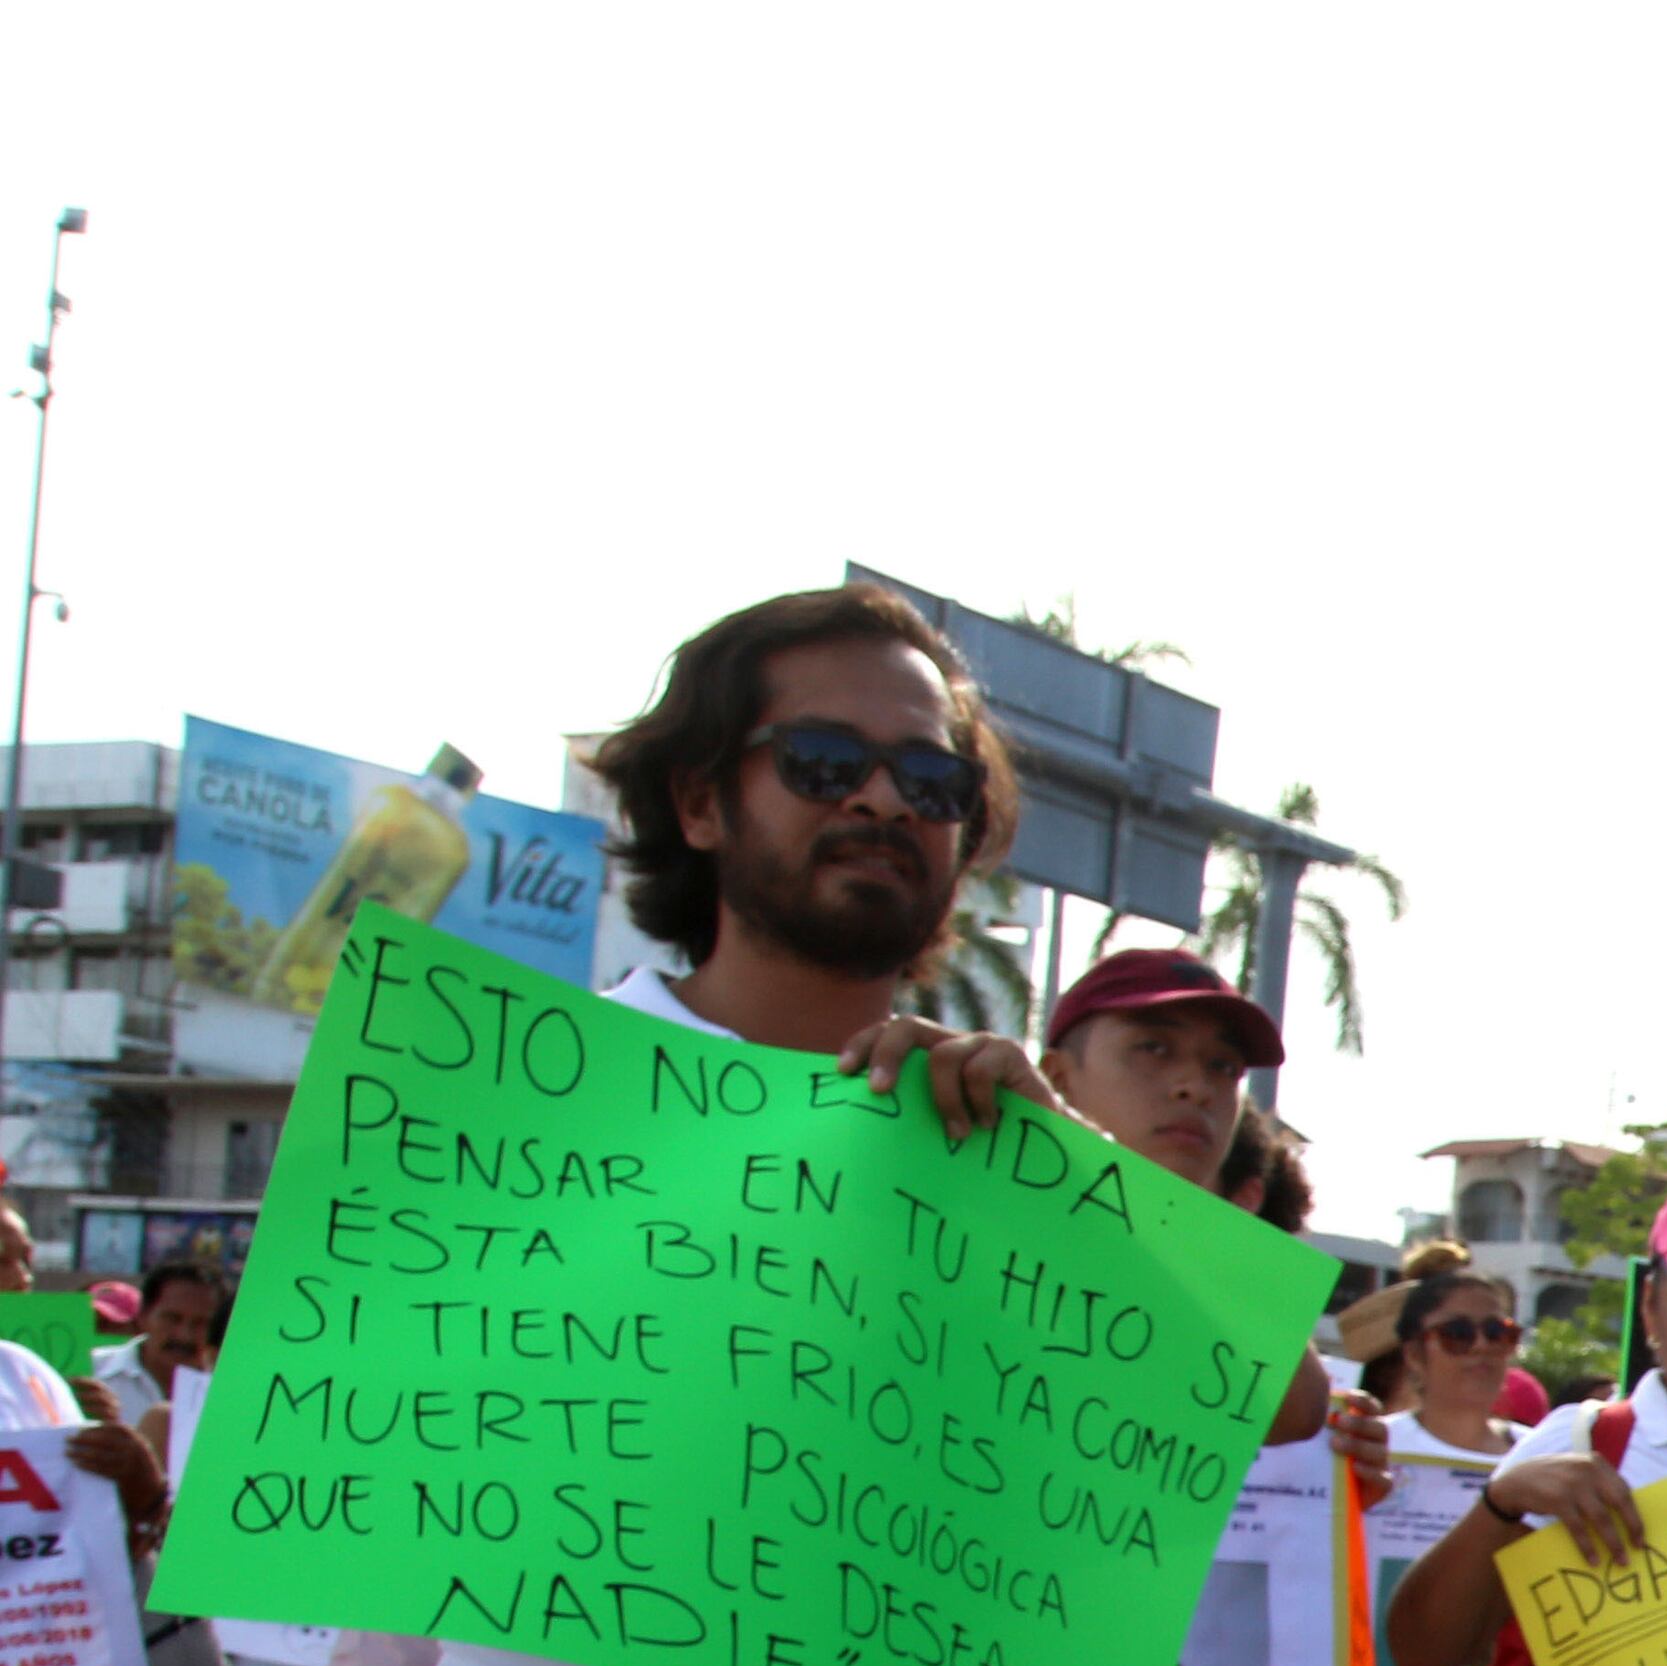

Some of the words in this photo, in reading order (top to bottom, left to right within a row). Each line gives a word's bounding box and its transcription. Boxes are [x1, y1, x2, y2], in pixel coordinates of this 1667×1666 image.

[197, 773, 335, 836] CANOLA
[485, 828, 586, 914] Vita
[341, 936, 586, 1096] "ESTO
[652, 1045, 767, 1116] NO
[343, 1073, 657, 1199] PENSAR
[742, 1153, 842, 1214] EN
[893, 1187, 969, 1284] TU
[1000, 1250, 1154, 1361] HIJO
[1191, 1341, 1270, 1424] SI
[253, 1371, 655, 1461] MUERTE
[278, 1276, 361, 1346] SI
[408, 1301, 670, 1375] TIENE
[727, 1324, 923, 1460] FRIO,
[939, 1410, 1006, 1495] ES
[1039, 1471, 1160, 1569] UNA
[636, 1221, 868, 1331] BIEN,
[897, 1290, 947, 1378] SI
[983, 1341, 1054, 1433] YA
[1073, 1396, 1227, 1503] COMIO
[230, 1471, 375, 1536] QUE
[413, 1480, 520, 1543] NO
[552, 1482, 656, 1573] SE
[707, 1516, 787, 1601] LE
